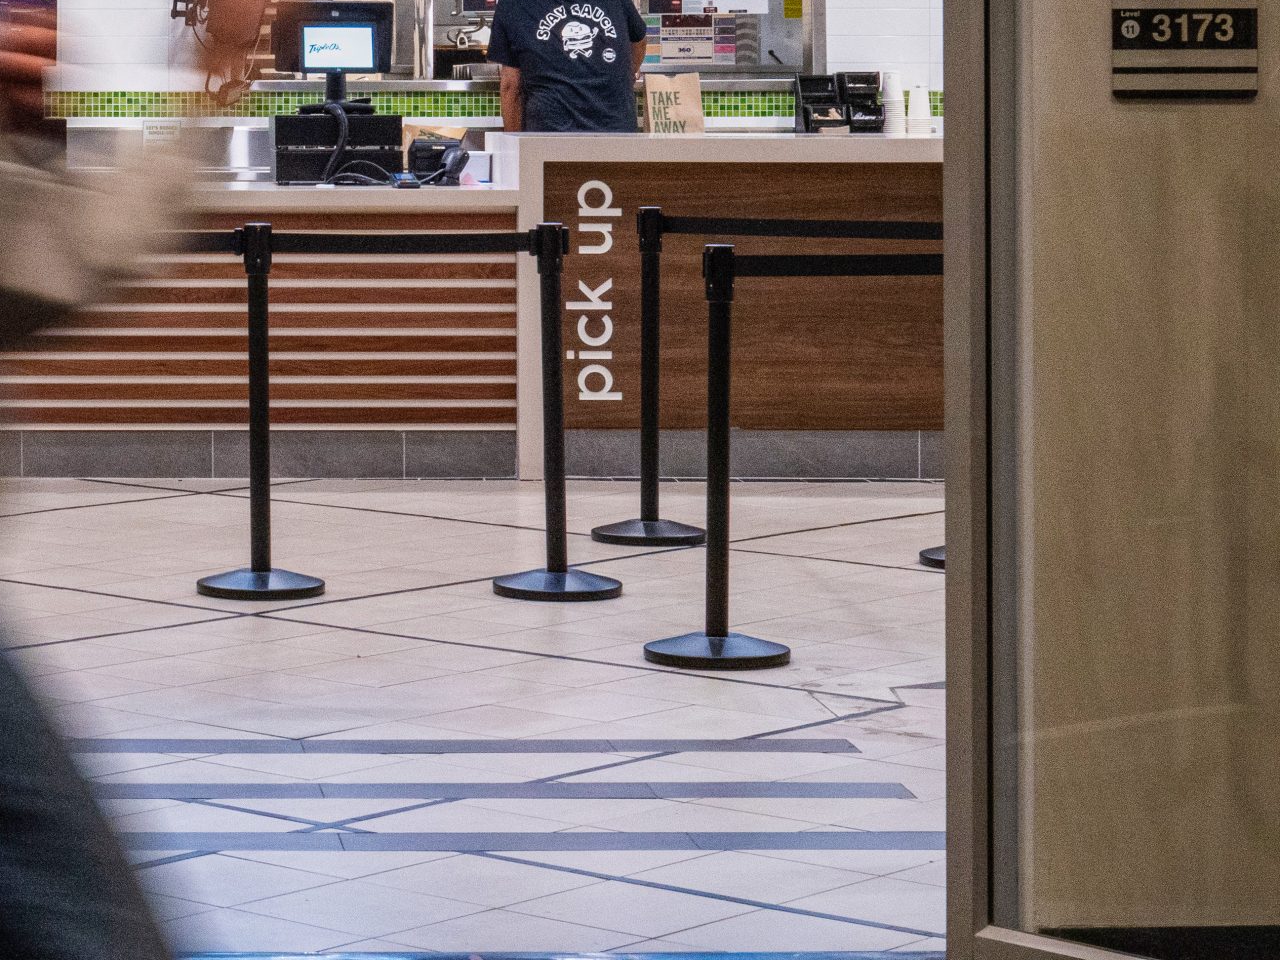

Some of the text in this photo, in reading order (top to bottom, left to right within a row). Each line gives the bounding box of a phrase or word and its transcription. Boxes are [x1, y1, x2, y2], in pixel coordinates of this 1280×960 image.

[536, 4, 617, 40] STAY SAUCY
[1124, 14, 1235, 42] 11 3173
[650, 91, 681, 105] TAKE
[652, 107, 670, 120] ME
[654, 121, 687, 133] AWAY
[565, 179, 623, 401] pick up
